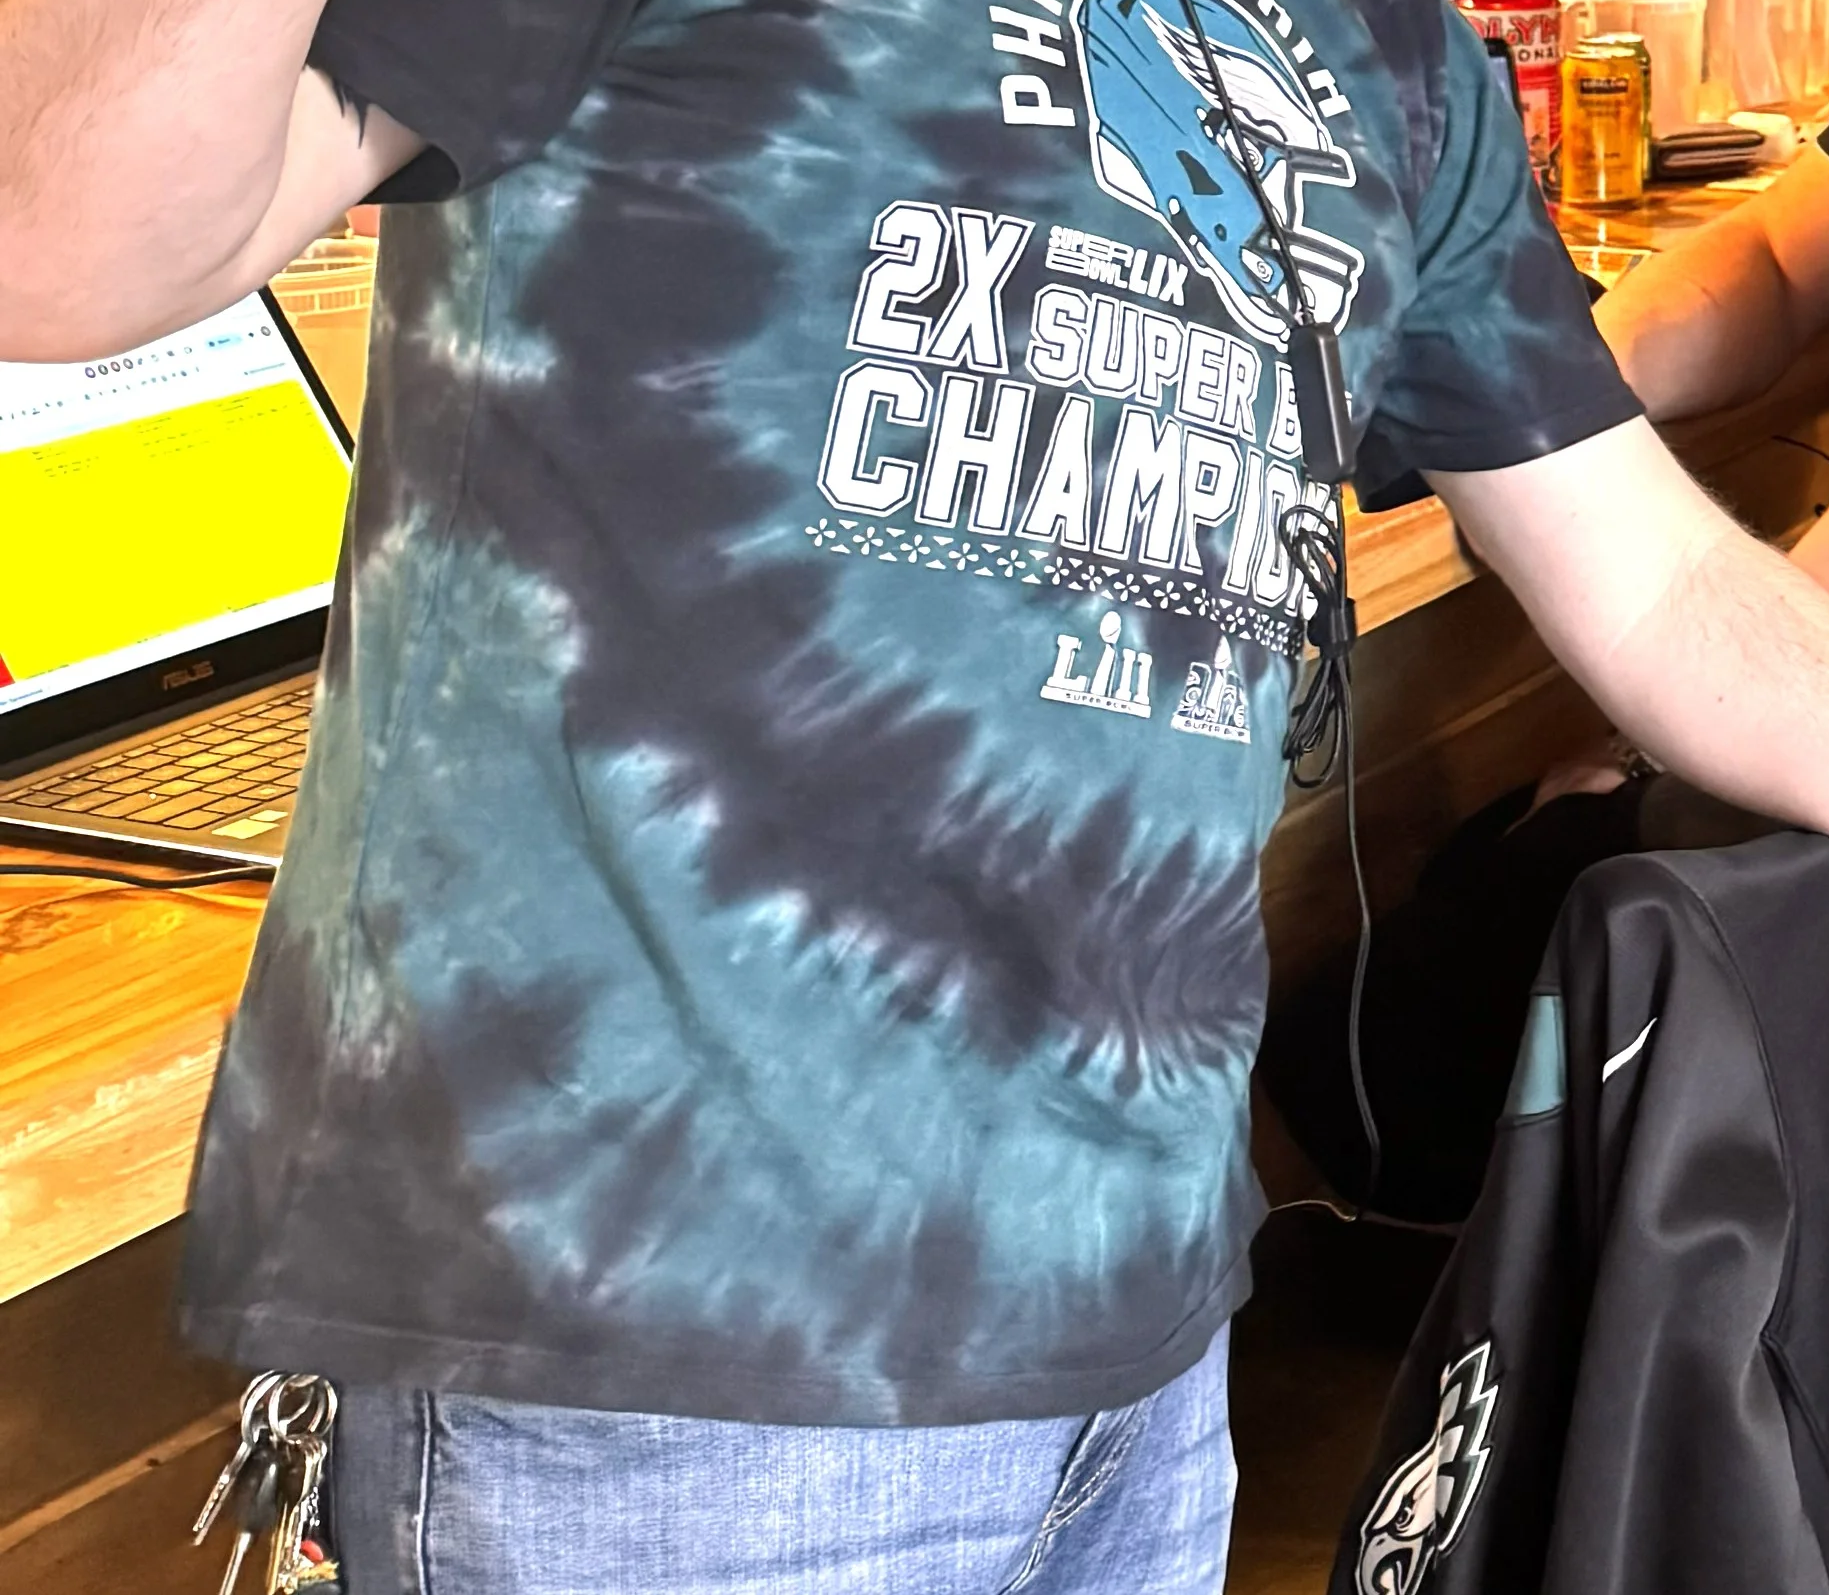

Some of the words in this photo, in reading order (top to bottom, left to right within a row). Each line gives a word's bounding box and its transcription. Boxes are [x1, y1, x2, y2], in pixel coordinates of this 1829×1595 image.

[1049, 225, 1135, 268] SUPER
[847, 201, 1035, 374] 2X
[1045, 246, 1129, 290] BOWL
[1128, 248, 1189, 306] LIX
[1026, 283, 1263, 443] SUPER
[1065, 692, 1103, 705] SUPER
[1183, 718, 1222, 733] SUPER
